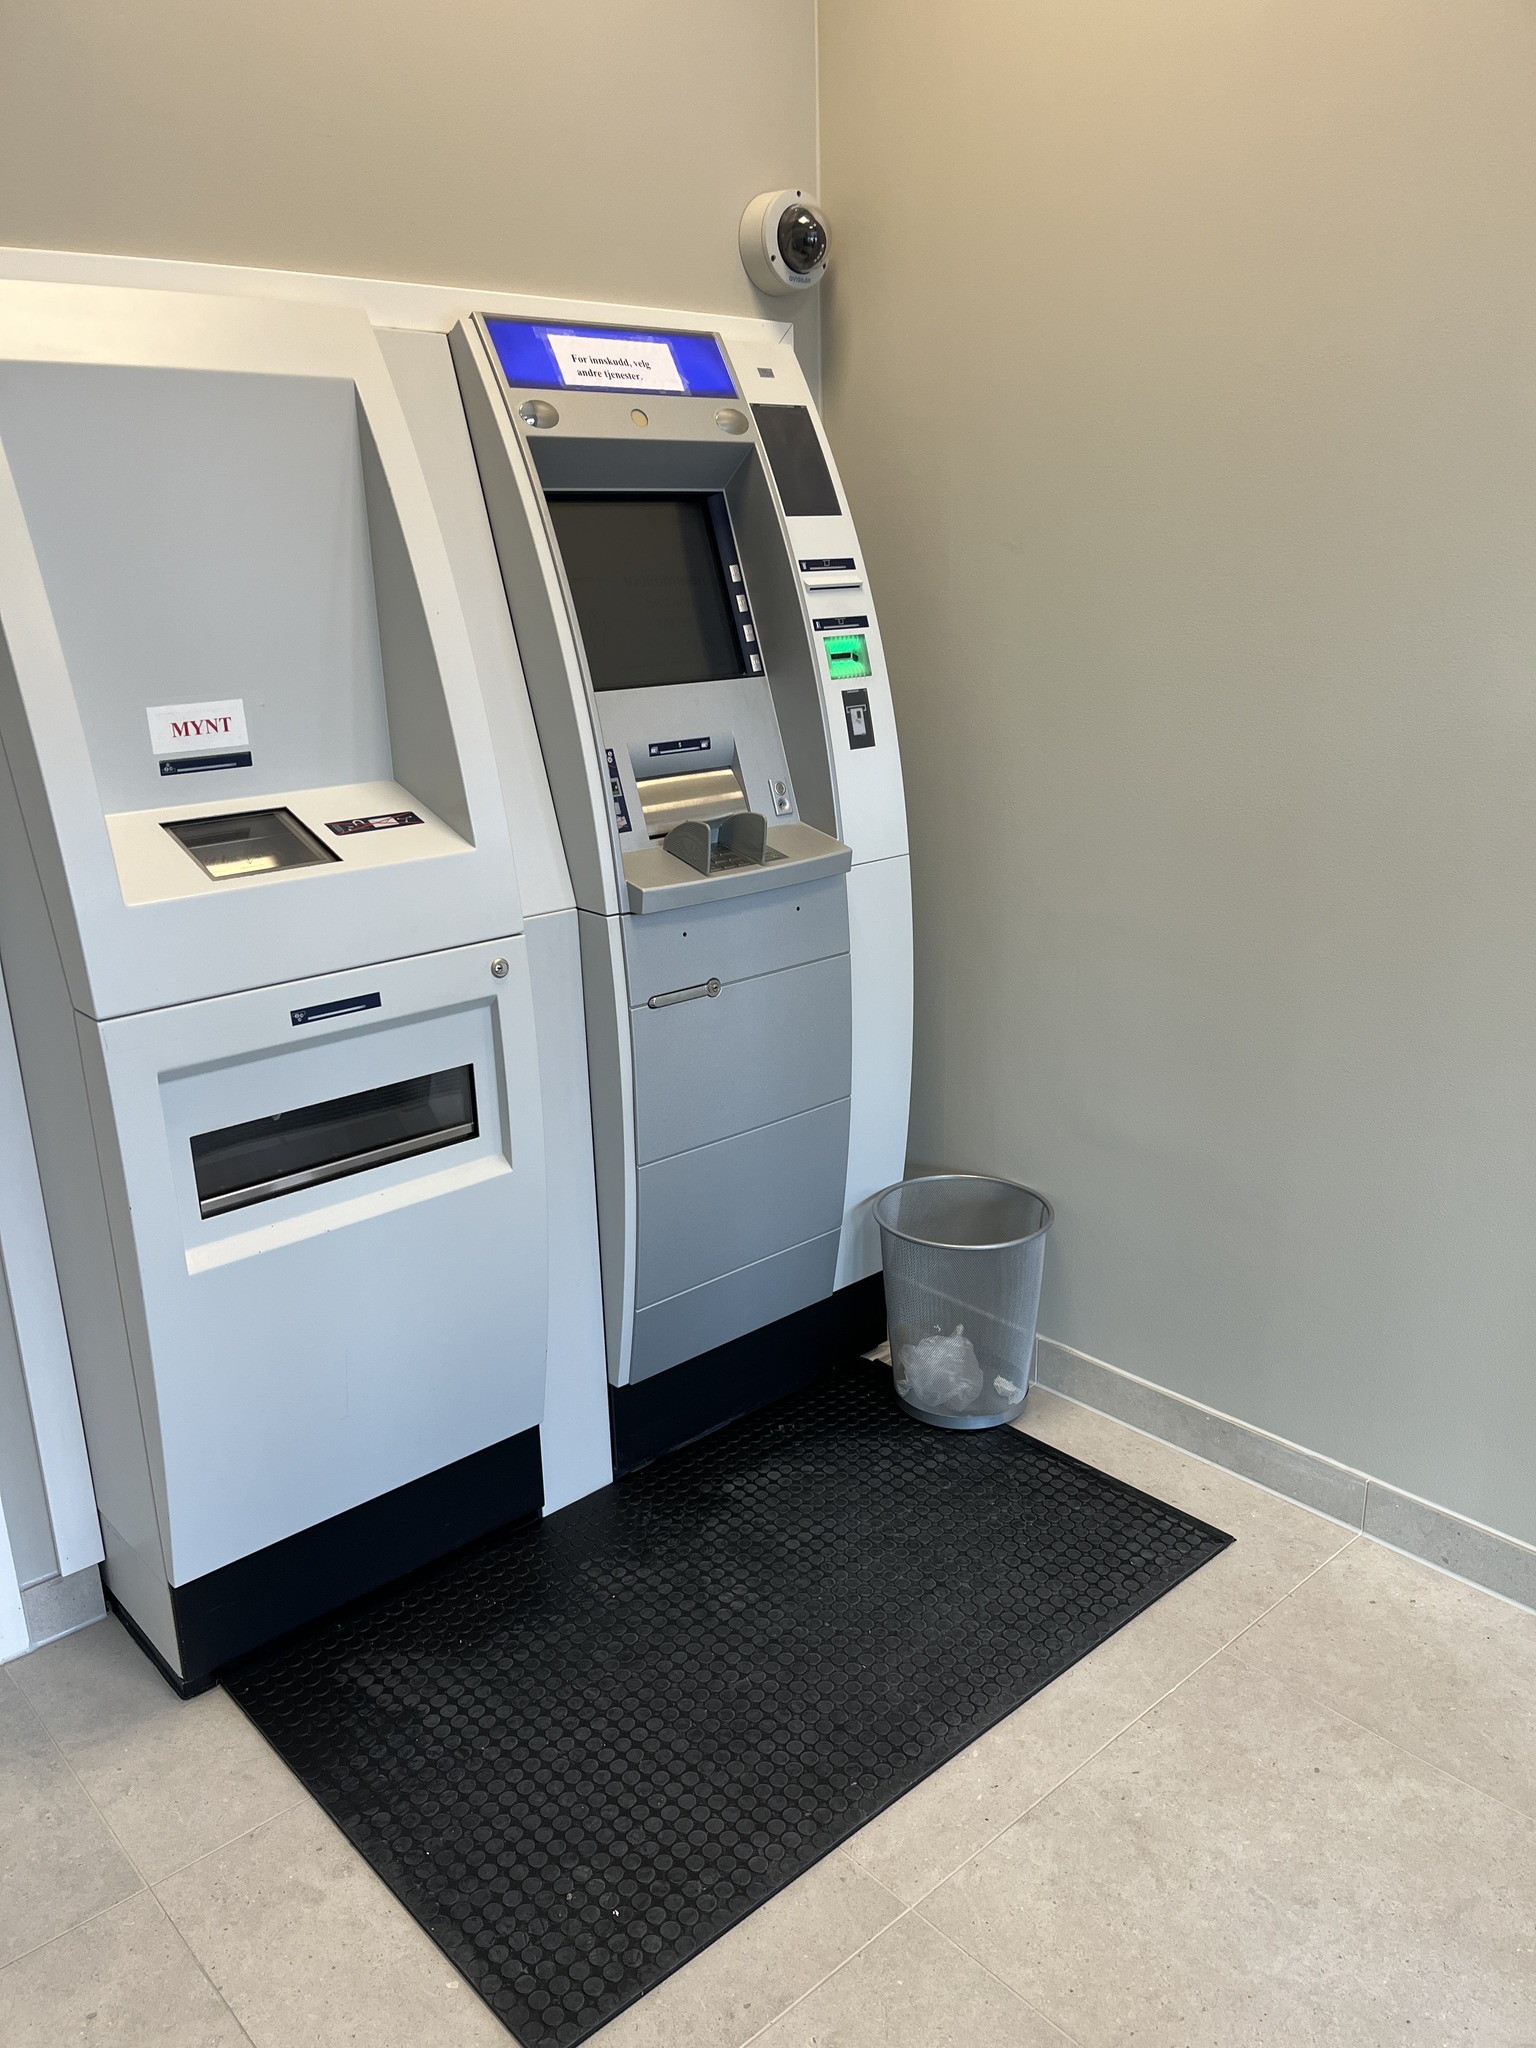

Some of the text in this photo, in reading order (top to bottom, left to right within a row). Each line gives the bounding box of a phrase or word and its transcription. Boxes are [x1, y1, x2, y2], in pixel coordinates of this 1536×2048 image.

[571, 354, 651, 370] For innskudd, velg
[577, 368, 643, 380] andre tjenester.
[171, 716, 232, 738] MYNT
